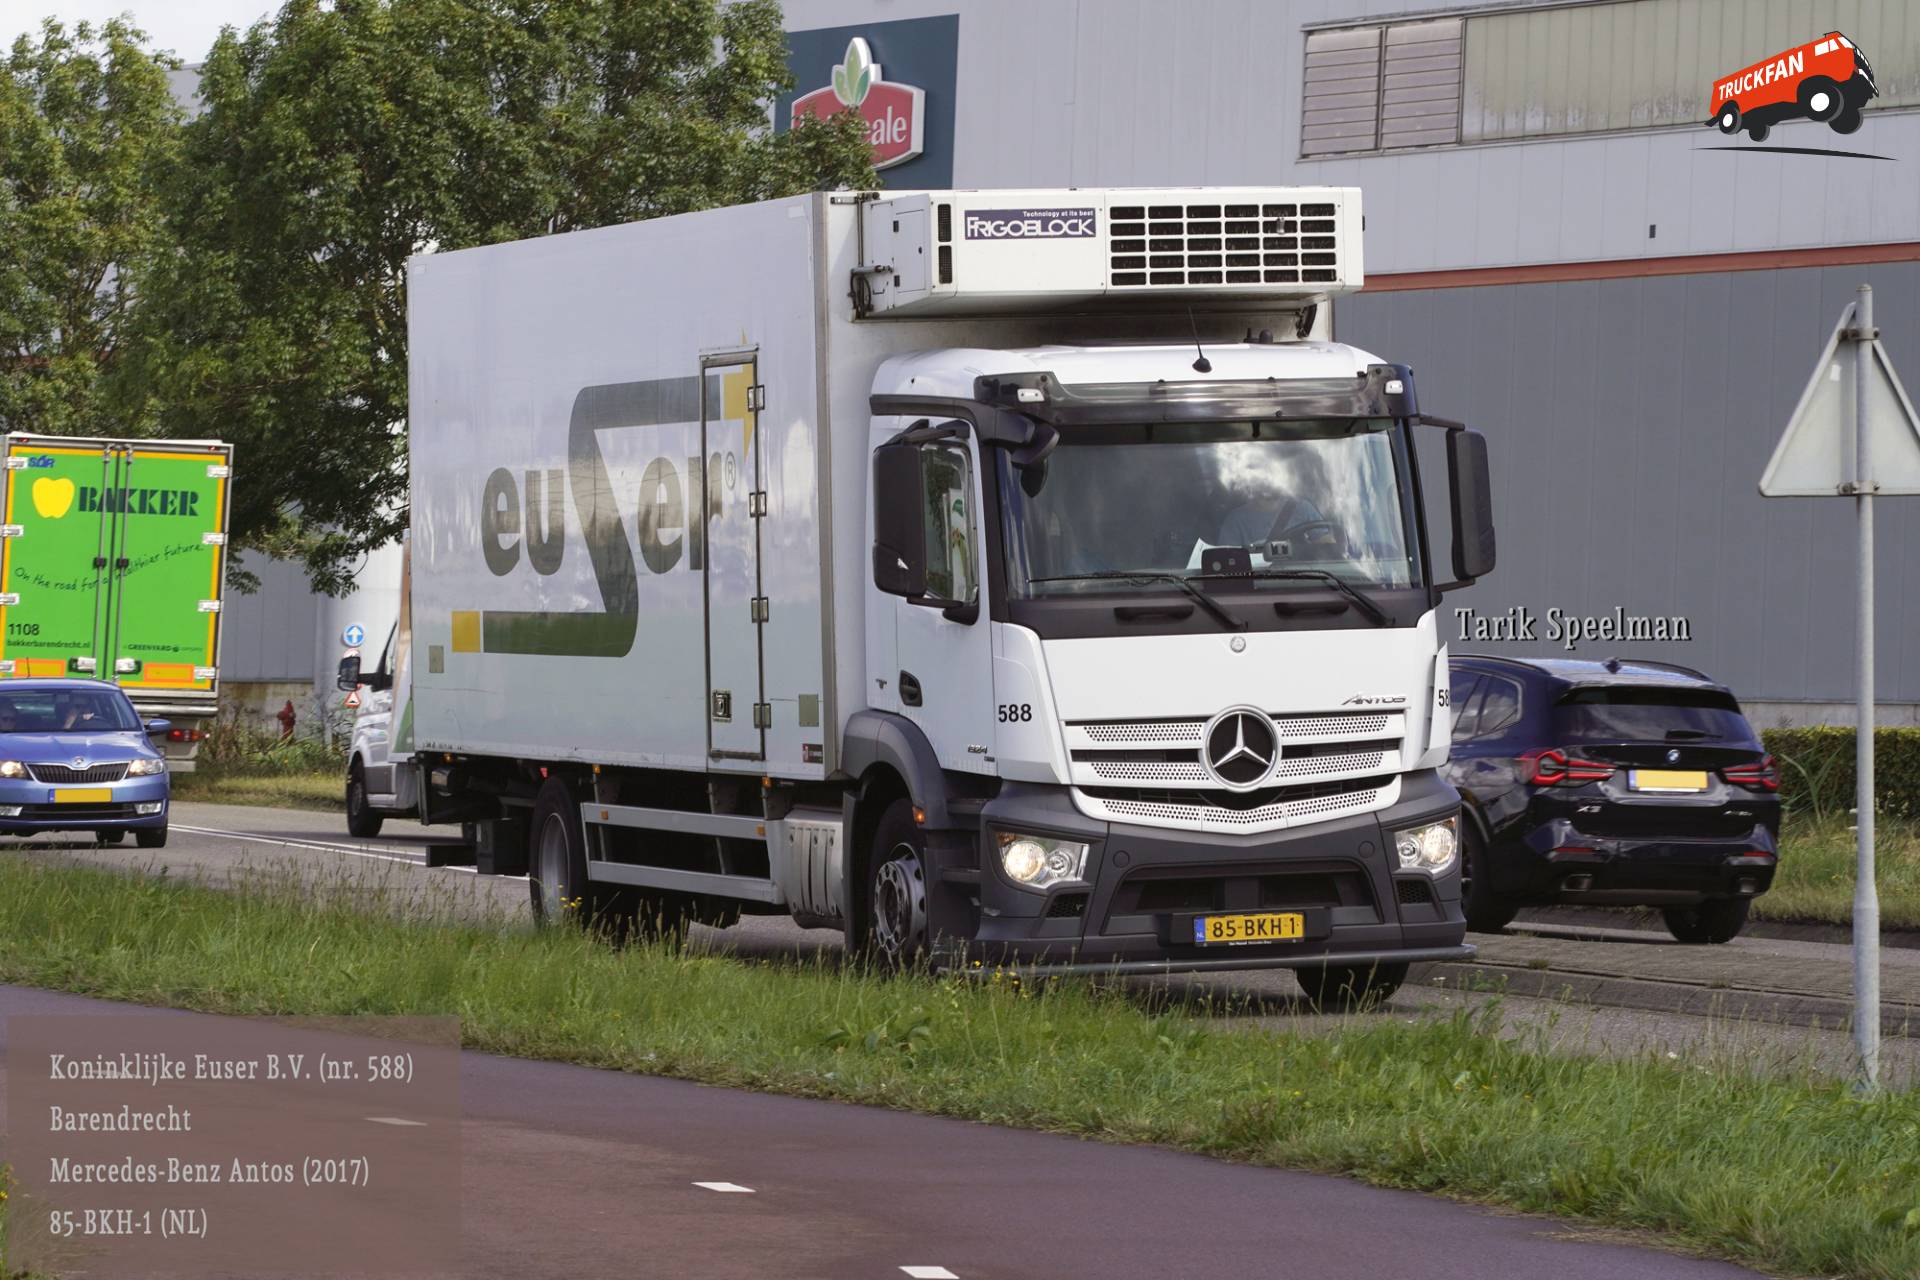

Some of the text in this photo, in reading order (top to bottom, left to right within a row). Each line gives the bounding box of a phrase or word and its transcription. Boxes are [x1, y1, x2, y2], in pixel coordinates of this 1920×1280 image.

[1022, 210, 1060, 218] Technology
[967, 216, 1094, 238] FRIGOBLOCK
[78, 486, 199, 516] BAKKER
[9, 623, 40, 636] 1108
[998, 703, 1032, 723] 588
